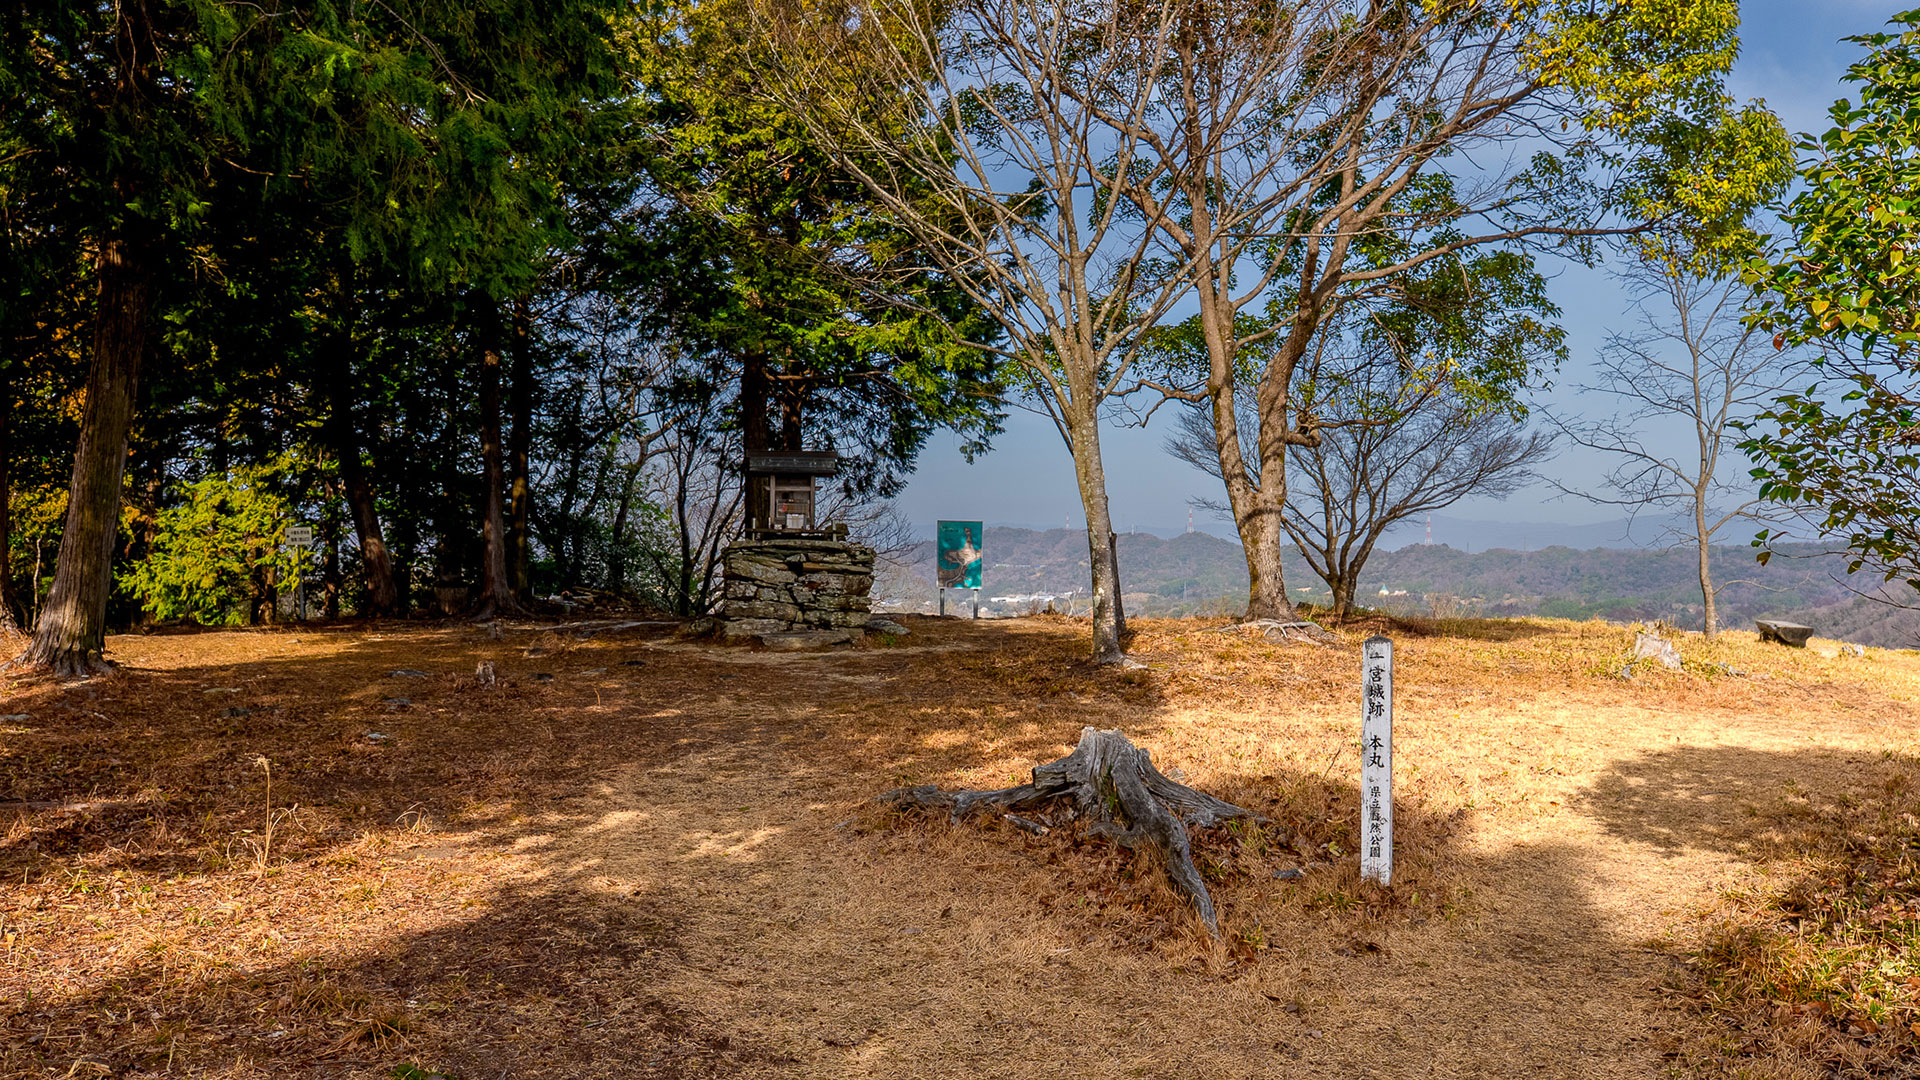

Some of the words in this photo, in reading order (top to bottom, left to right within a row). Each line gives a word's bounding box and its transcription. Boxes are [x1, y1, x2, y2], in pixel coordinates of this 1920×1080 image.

[1368, 653, 1385, 717] 一宮城跡
[1368, 734, 1385, 769] 本丸
